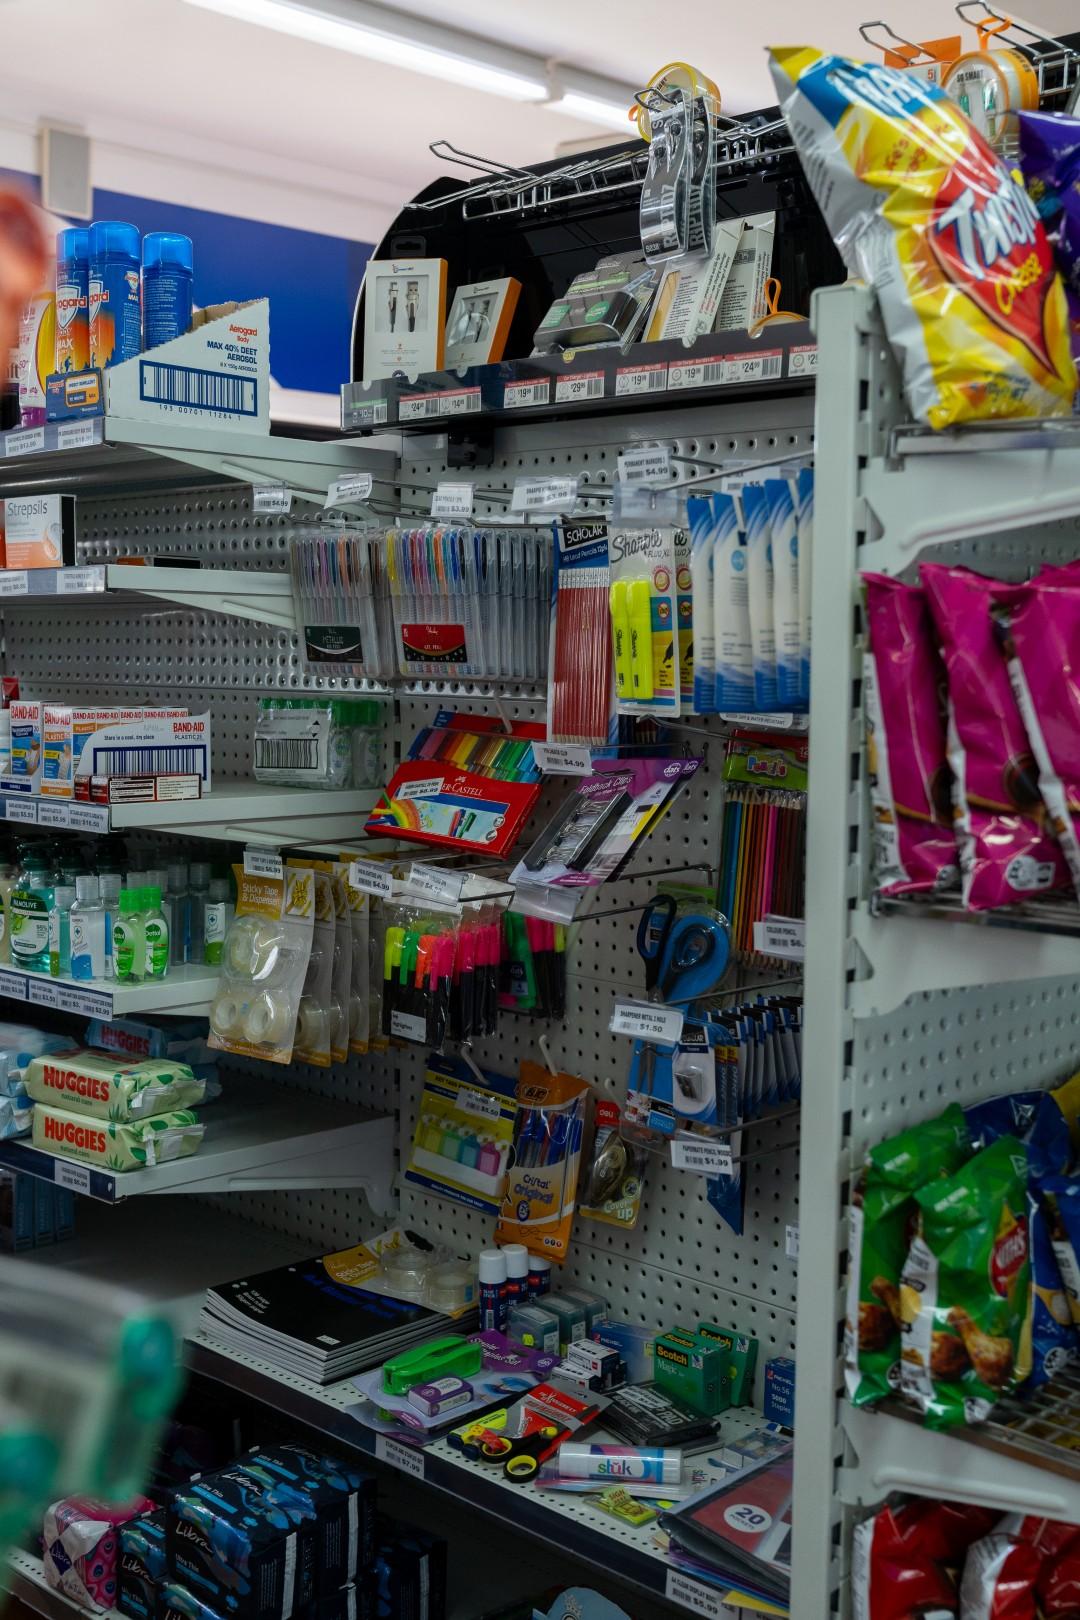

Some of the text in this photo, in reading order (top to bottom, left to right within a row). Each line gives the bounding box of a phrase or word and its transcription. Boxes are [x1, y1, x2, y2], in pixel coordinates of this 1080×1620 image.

[229, 323, 258, 337] Aerogard
[236, 335, 250, 344] Body
[207, 341, 258, 357] MAX 40% DEET
[227, 352, 258, 365] AEROSOL
[646, 467, 667, 476] $4.99
[7, 500, 48, 516] Strepsils
[567, 523, 603, 544] SCHOLAR
[610, 530, 662, 563] Sharpie
[569, 552, 581, 561] Lead
[581, 549, 597, 558] Pencils
[11, 705, 38, 720] BAND-AID
[45, 713, 71, 726] BAND-AID
[121, 711, 142, 719] BAND-AID
[144, 711, 166, 719] BAND-AID
[173, 722, 204, 733] BAND-AID
[564, 758, 585, 768] $4.99
[442, 783, 483, 796] ER-CASTELL
[372, 881, 389, 891] $4.99
[640, 1023, 662, 1032] $1.50
[102, 1024, 149, 1055] HUGGIES
[43, 1065, 109, 1101] HUGGIES
[44, 1117, 106, 1152] HUGGIES
[704, 1157, 728, 1167] $1.99
[523, 1174, 549, 1189] Cristal
[515, 1184, 553, 1204] Original
[657, 1346, 688, 1365] Scotch
[657, 1359, 677, 1374] Magic
[402, 1459, 420, 1472] $7.99
[198, 1483, 224, 1498] Ultra Thin
[221, 1472, 262, 1496] Libra
[735, 1508, 765, 1524] 20
[176, 1520, 213, 1552] Libra
[121, 1555, 155, 1585] Libra
[693, 1597, 718, 1615] $5.99
